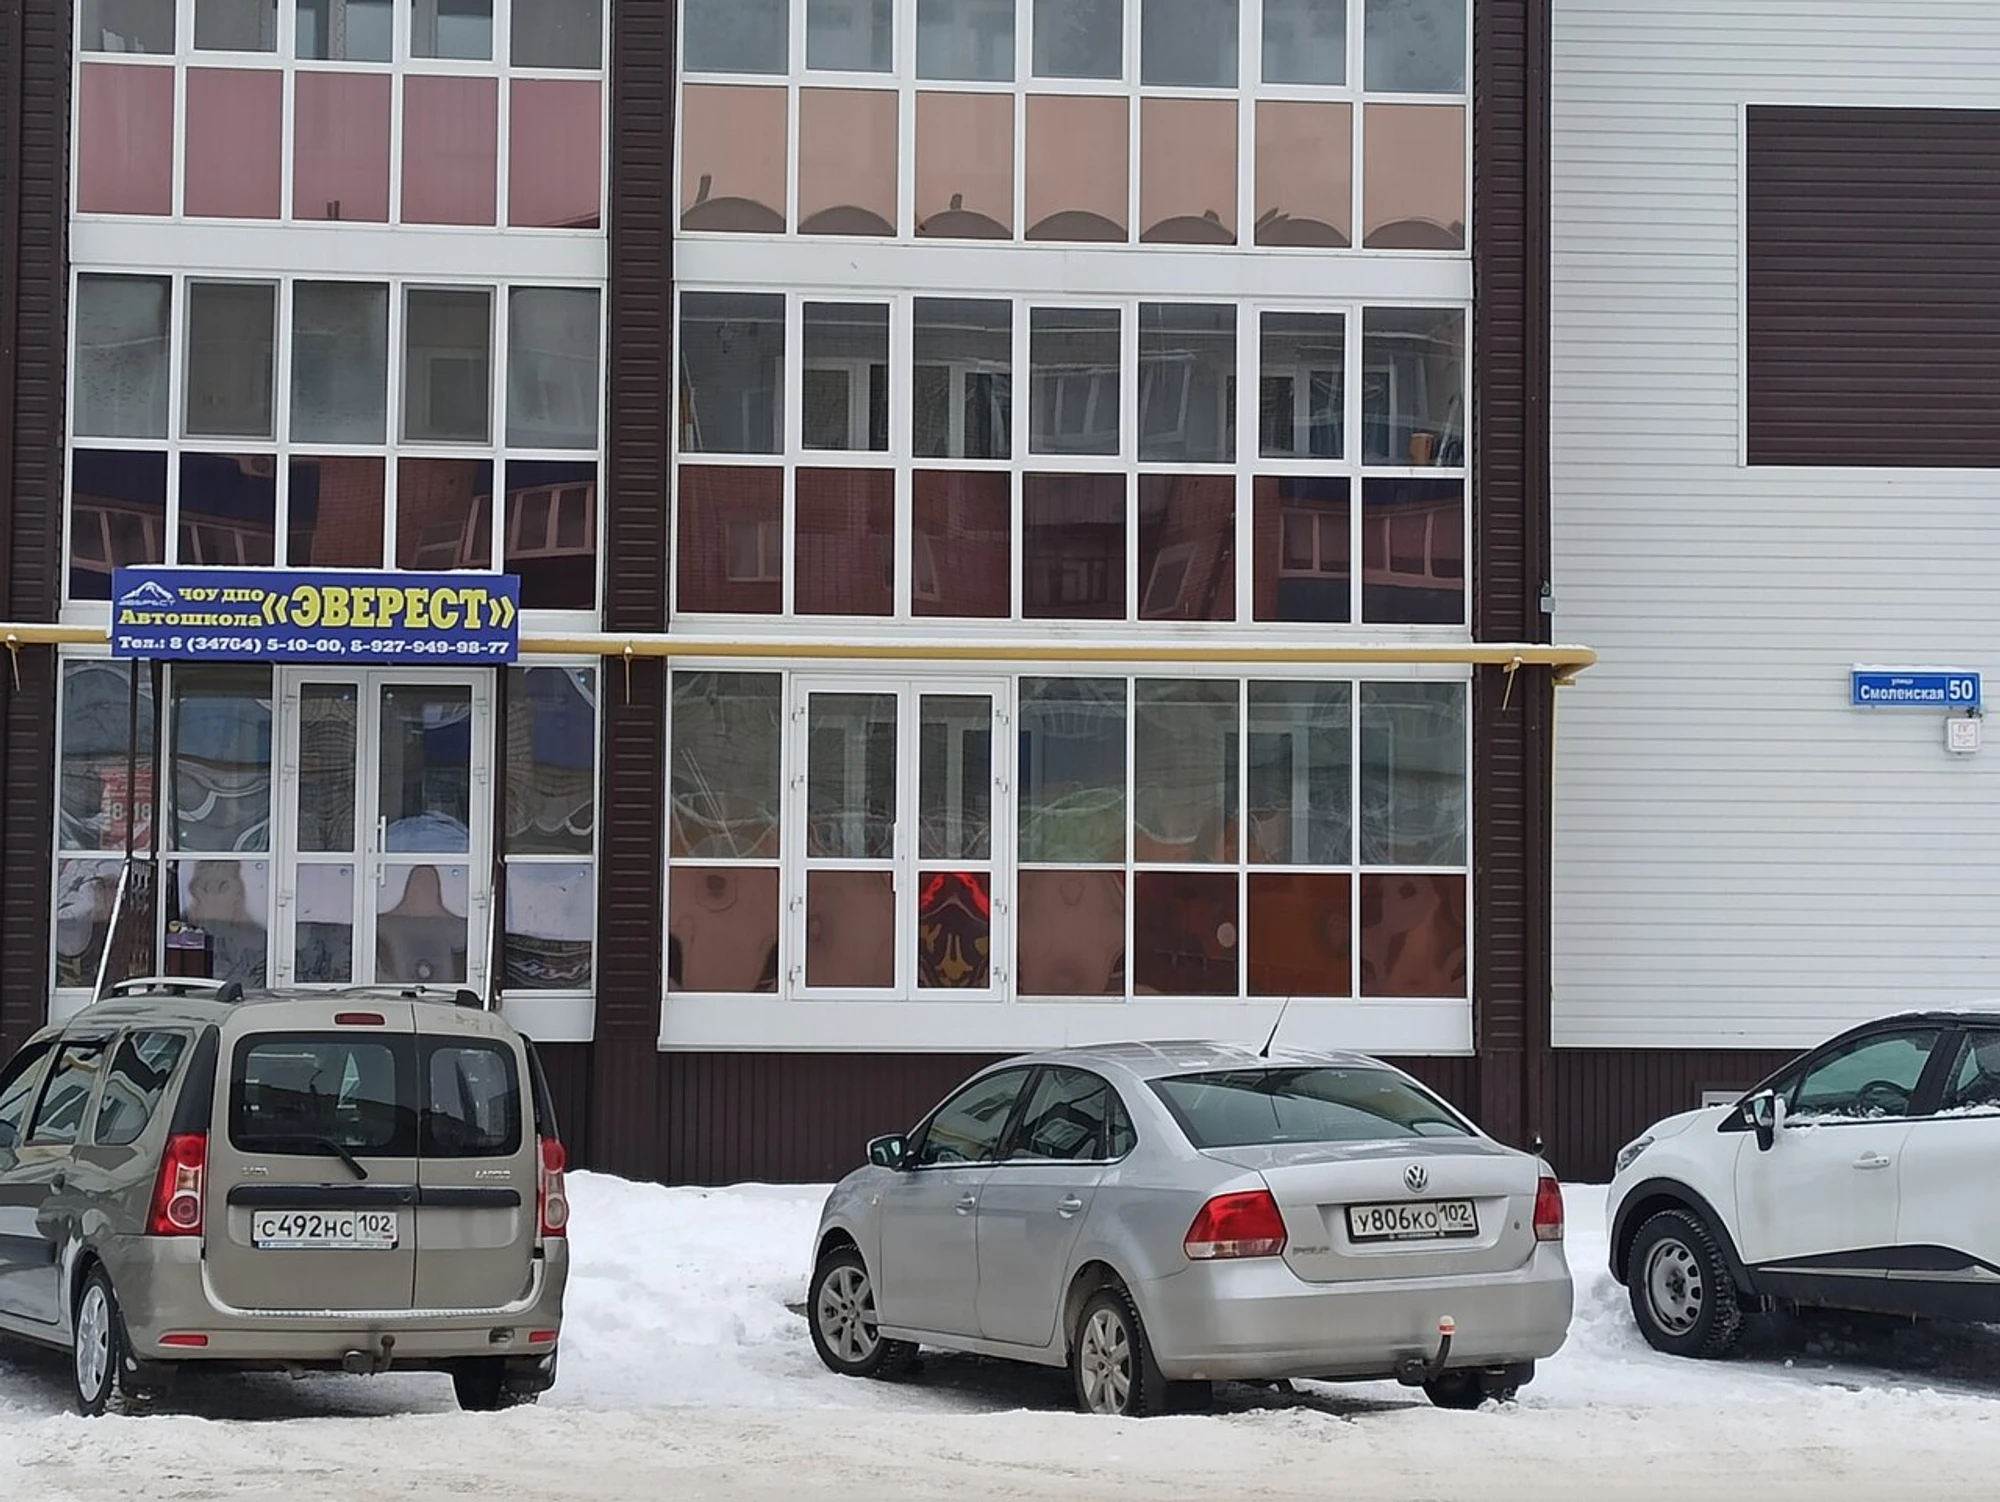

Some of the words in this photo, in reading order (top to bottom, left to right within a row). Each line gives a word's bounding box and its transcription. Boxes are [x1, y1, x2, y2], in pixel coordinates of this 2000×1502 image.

[118, 609, 262, 626] Автошкола
[262, 585, 515, 629] «ЭВЕРЕСТ»
[118, 636, 165, 649] Тел.:
[169, 637, 182, 649] 8
[187, 637, 262, 653] (34764)
[266, 638, 346, 655] 5-10-00,
[350, 639, 509, 654] 8-927-949-98-77
[1860, 685, 1945, 699] Смоленская
[1949, 680, 1973, 699] 50
[262, 1214, 353, 1238] С492НС
[358, 1214, 391, 1232] 102
[1358, 1207, 1438, 1233] У806КО
[1439, 1203, 1469, 1222] 102
